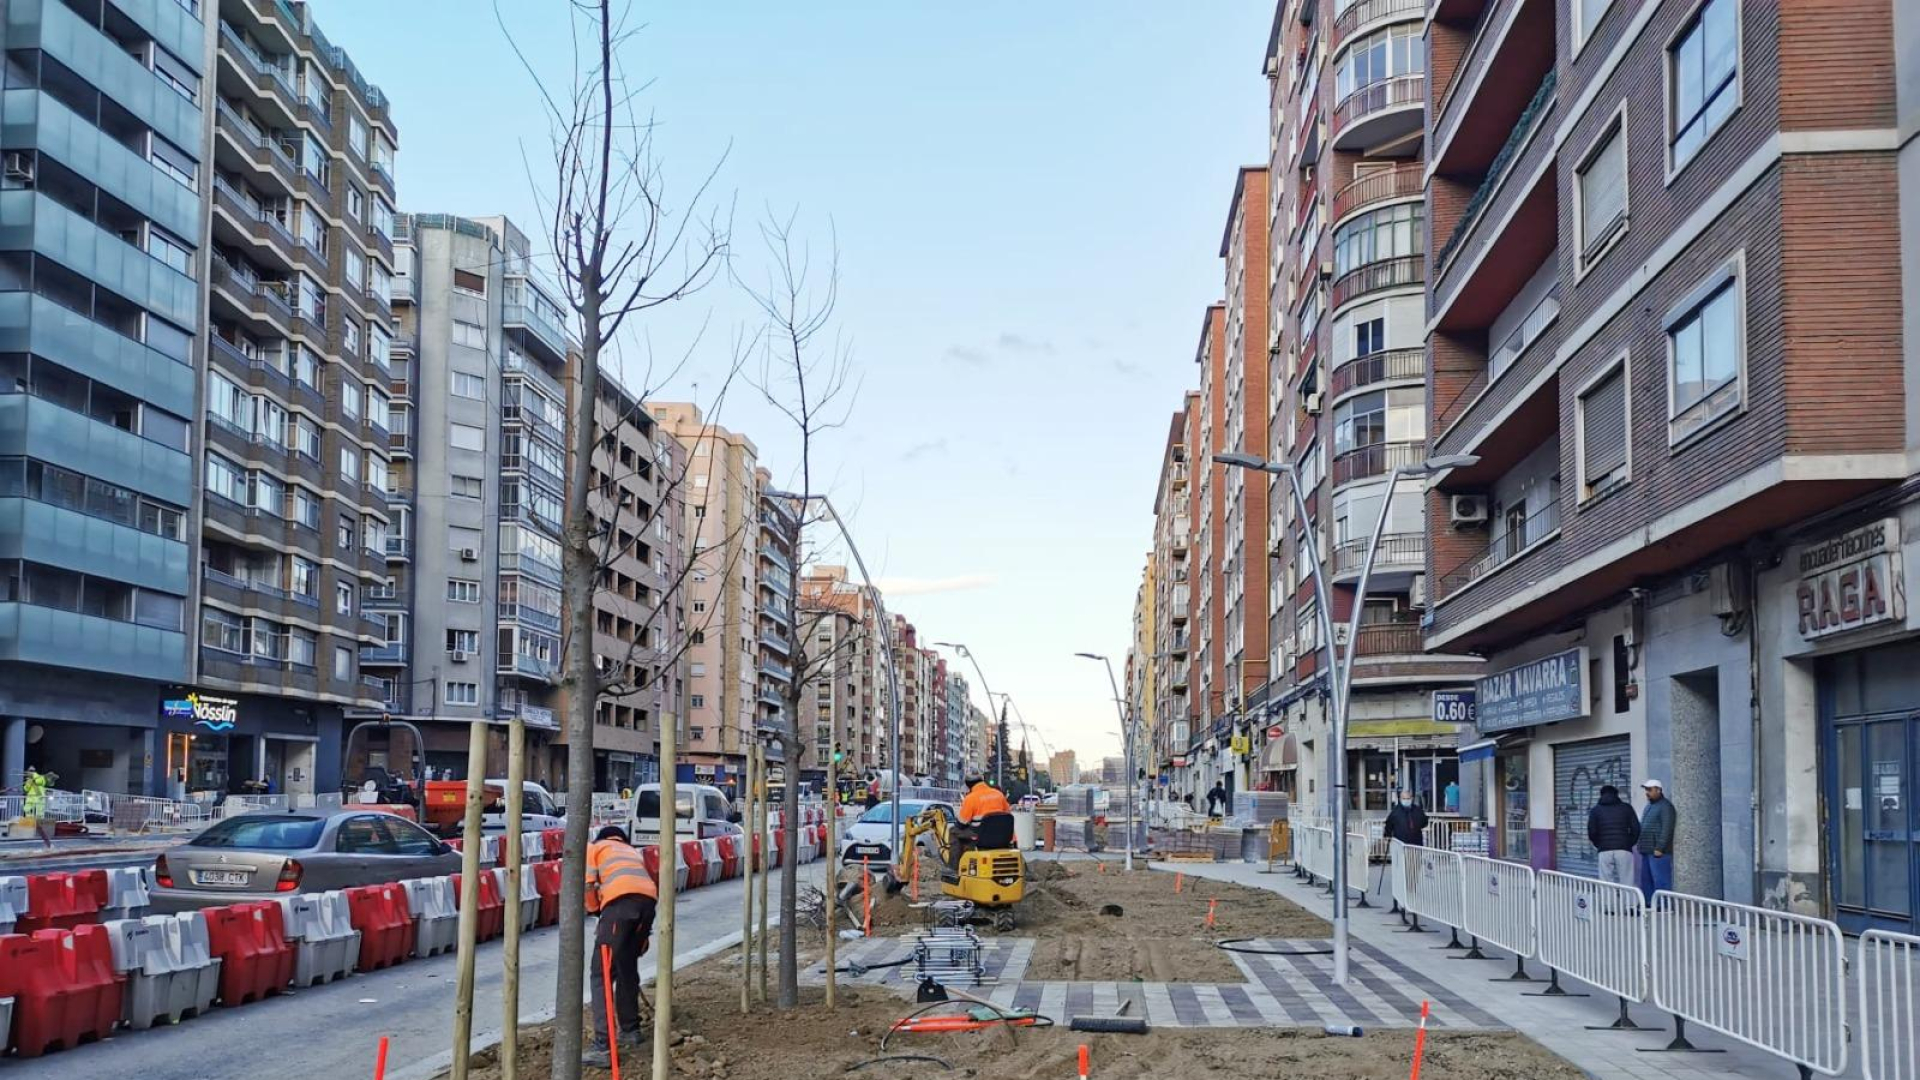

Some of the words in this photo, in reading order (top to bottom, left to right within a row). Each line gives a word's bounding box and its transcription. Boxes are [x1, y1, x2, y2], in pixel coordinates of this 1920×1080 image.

[1797, 565, 1886, 635] RAGA
[1482, 673, 1512, 704] BAZAR
[1515, 657, 1567, 697] NAVARRA
